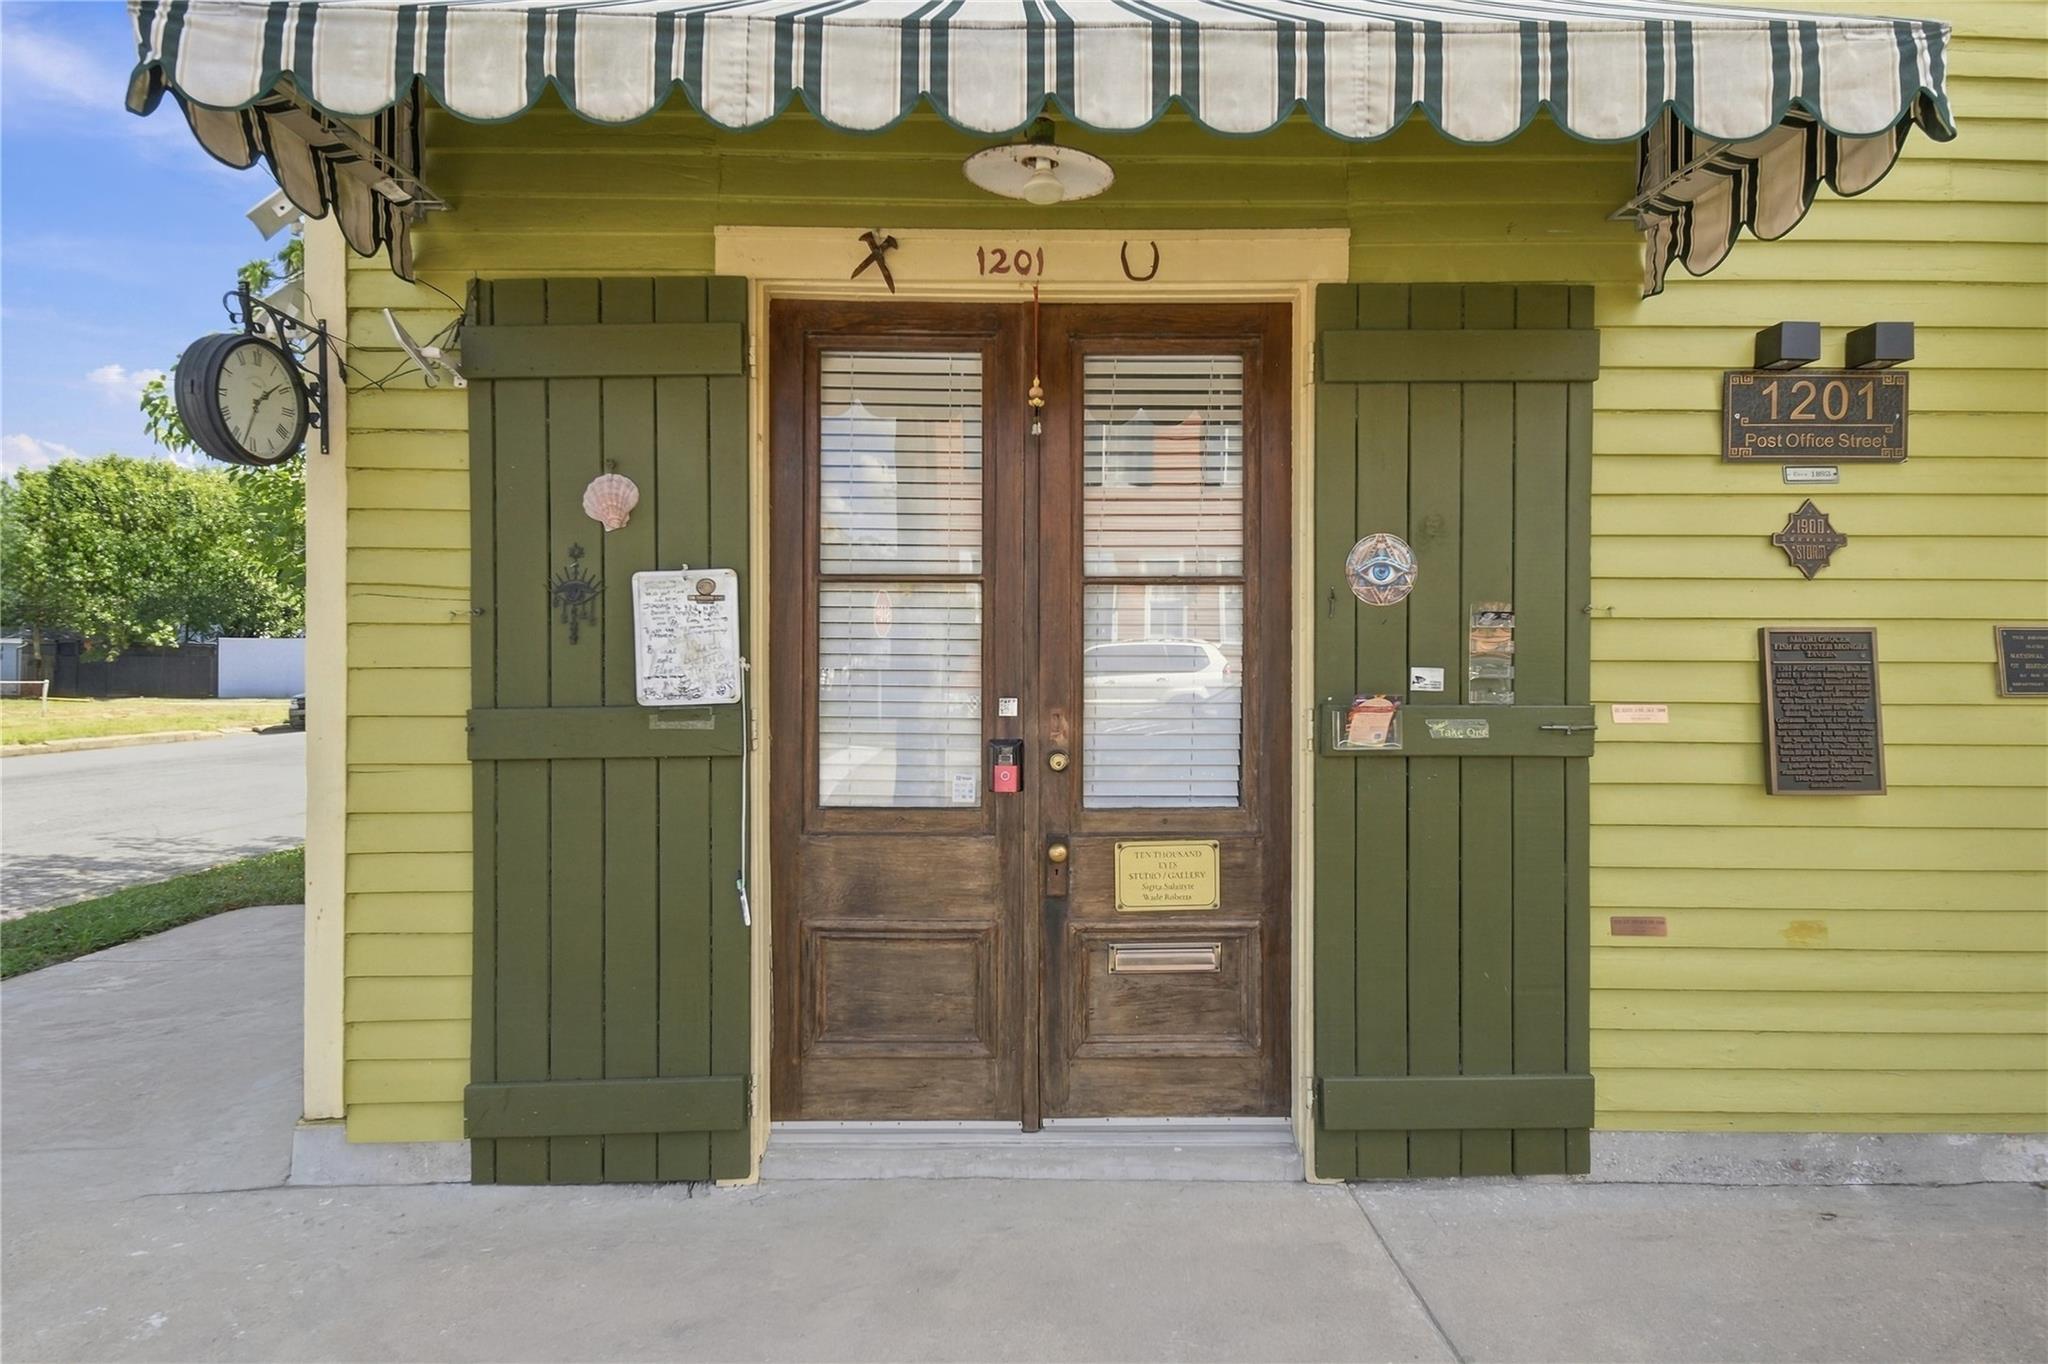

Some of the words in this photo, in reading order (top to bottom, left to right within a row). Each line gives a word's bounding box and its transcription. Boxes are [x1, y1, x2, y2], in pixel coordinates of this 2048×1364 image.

[976, 246, 1045, 276] 1201
[1761, 380, 1874, 421] 1201
[1745, 433, 1783, 448] Post
[1785, 433, 1834, 448] Office
[1837, 433, 1888, 448] Street
[1796, 519, 1825, 534] 1900
[1796, 545, 1826, 560] STORM
[1774, 643, 1792, 651] FISH
[1801, 643, 1833, 651] OYSTER
[1438, 728, 1463, 738] Take
[1134, 851, 1152, 859] TEN
[1153, 850, 1202, 859] THOUSAND
[1128, 872, 1162, 880] STUDIO
[1167, 871, 1206, 880] GALLERY
